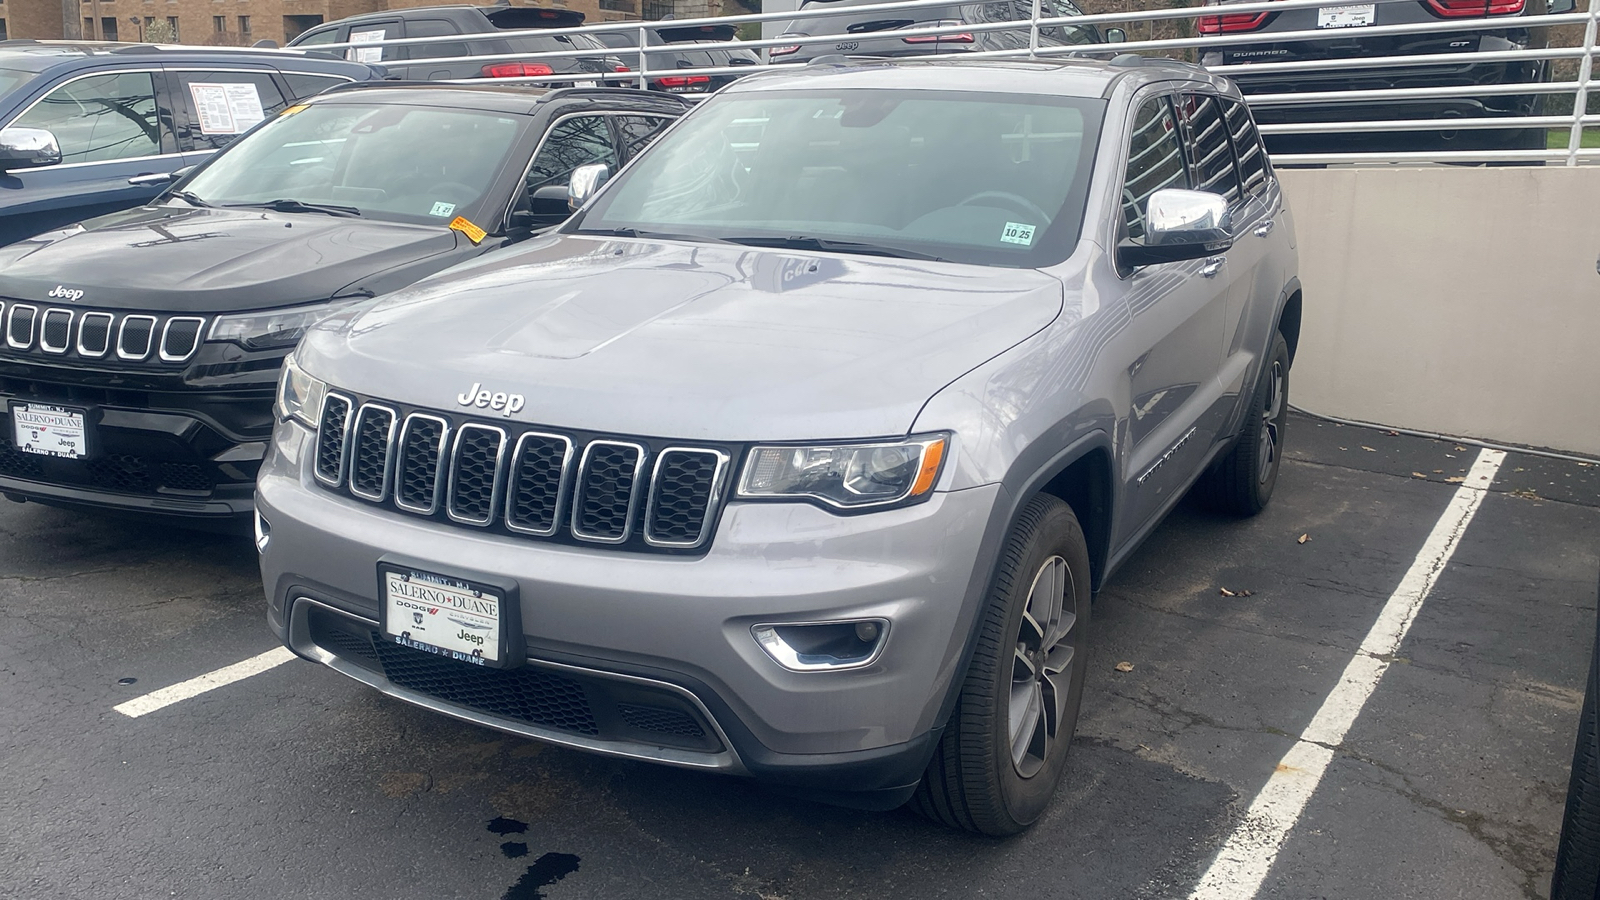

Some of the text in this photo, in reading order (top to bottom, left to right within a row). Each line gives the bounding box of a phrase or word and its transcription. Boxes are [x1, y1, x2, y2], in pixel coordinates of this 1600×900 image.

[836, 42, 859, 51] Jeep
[1232, 49, 1288, 58] DURANGO
[1005, 228, 1031, 240] 10 25
[48, 285, 84, 302] Jeep
[457, 382, 525, 418] Jeep
[16, 413, 83, 428] SALERNO DUANE
[58, 438, 76, 448] Jeep
[22, 447, 78, 460] SALERNO DUANE
[390, 581, 498, 617] SALERNO DUANE
[457, 629, 484, 646] Jeep
[395, 636, 485, 666] SALERNO DUANE
